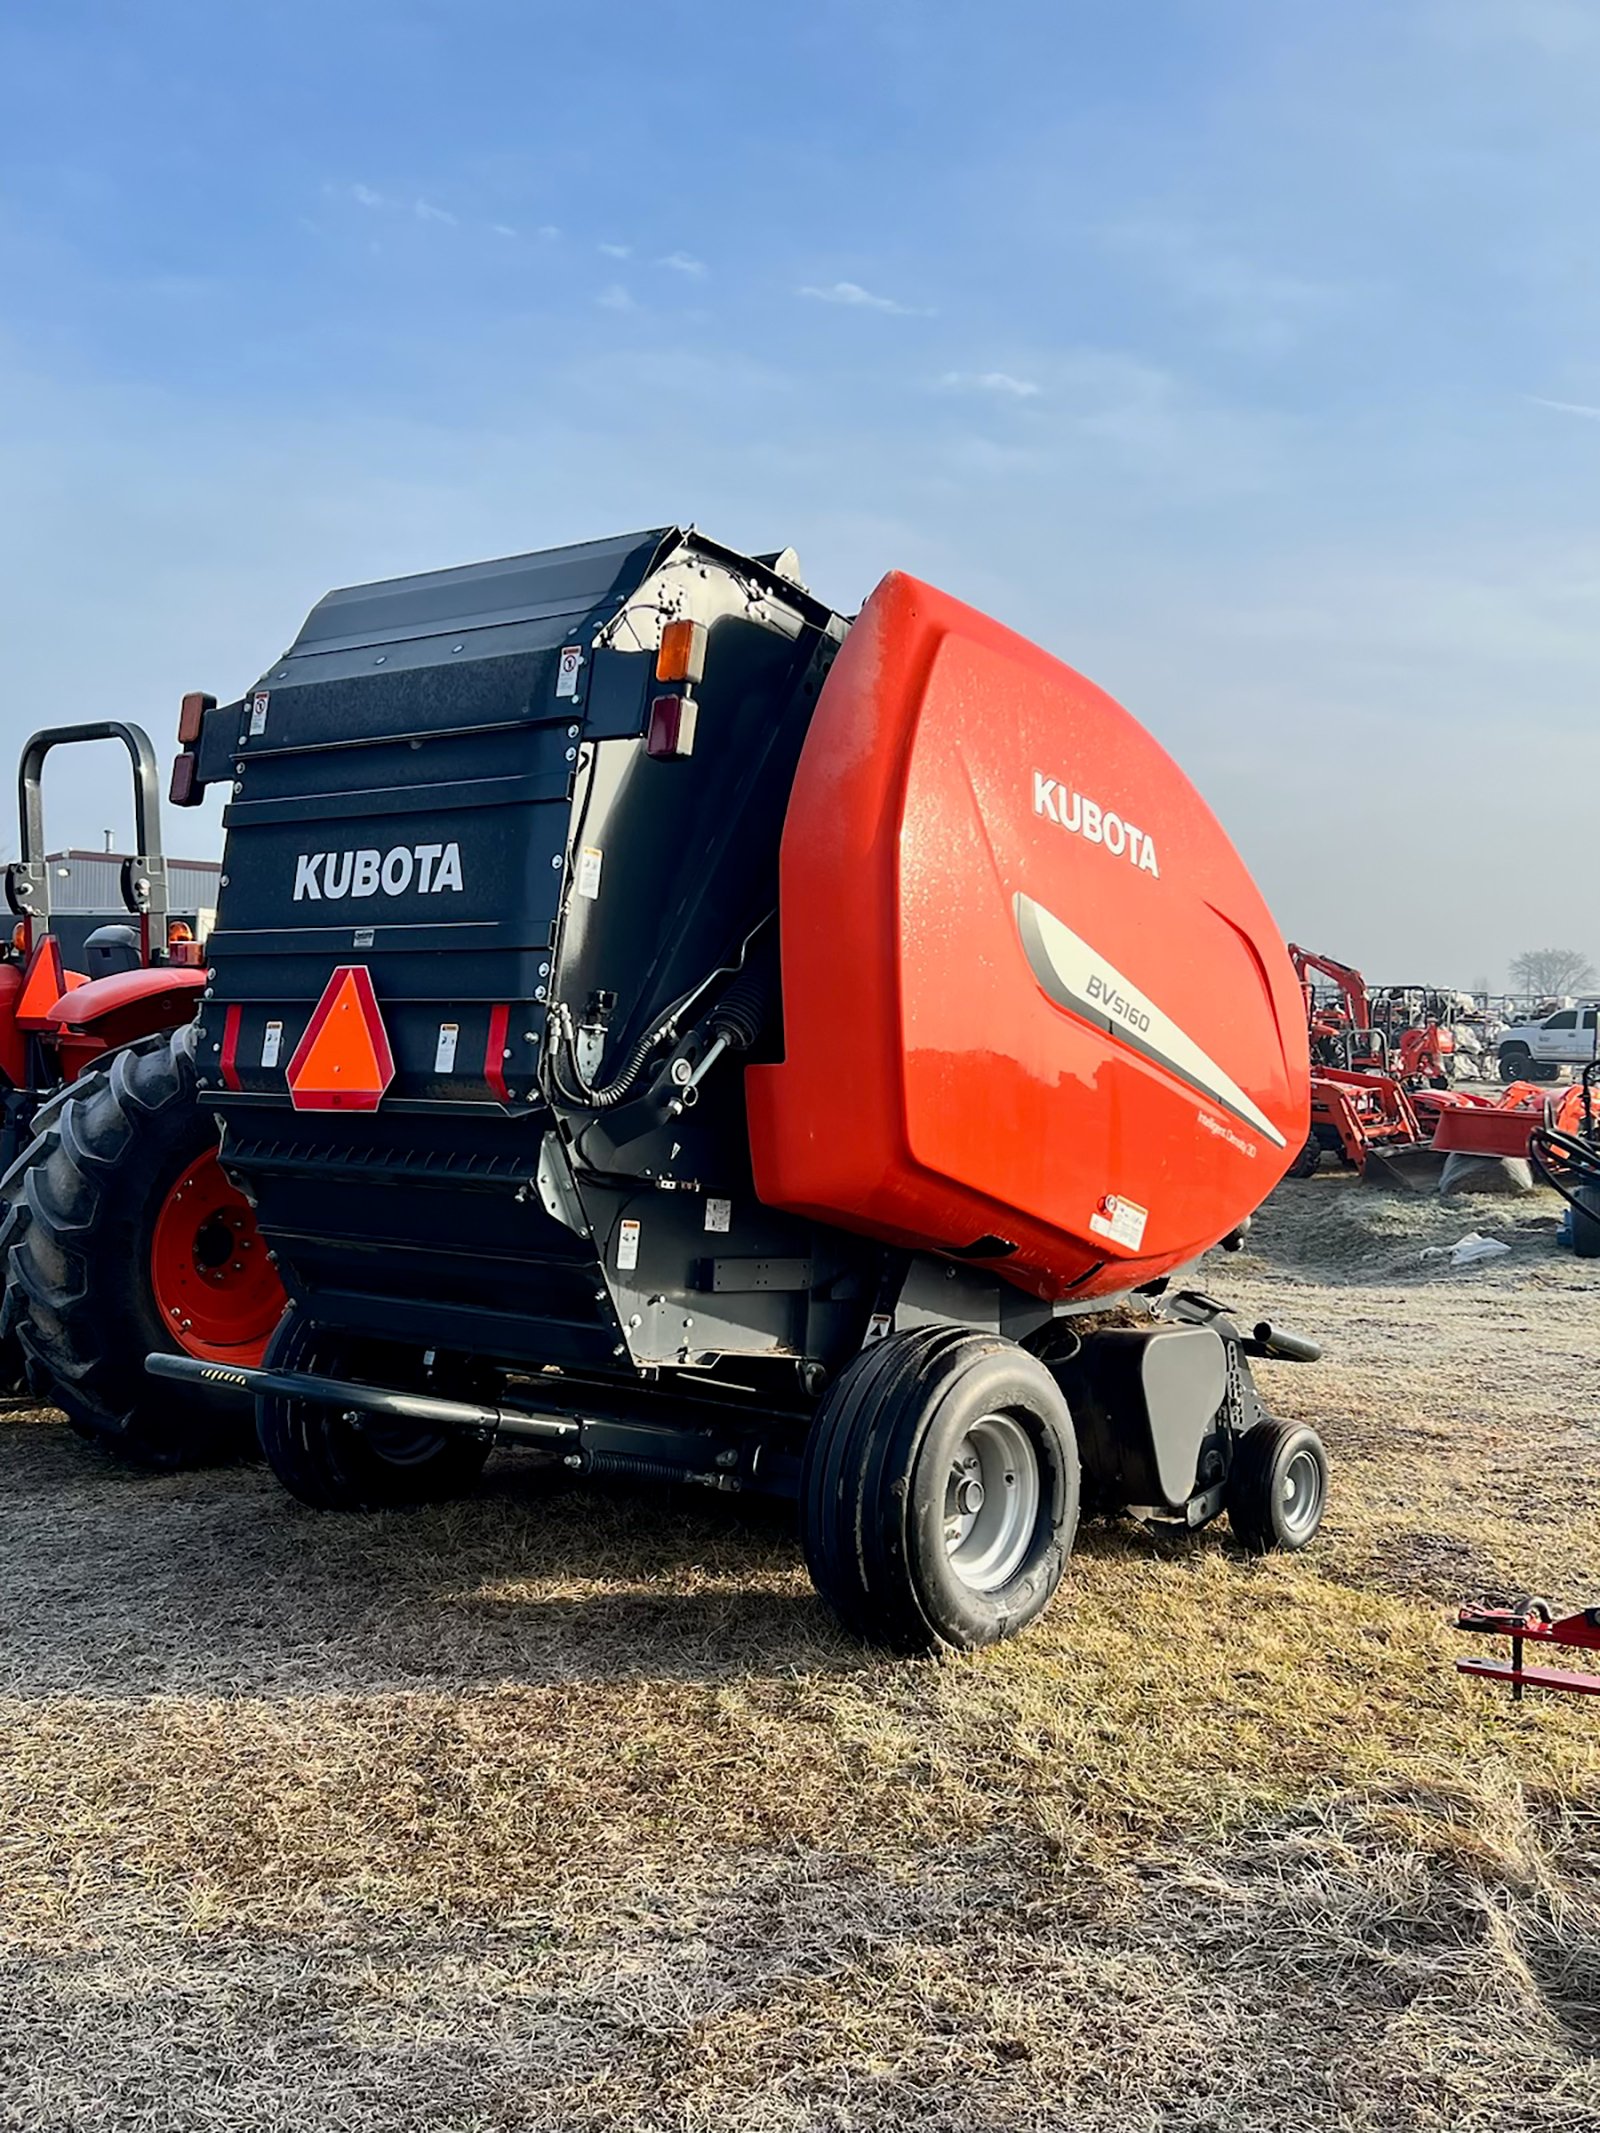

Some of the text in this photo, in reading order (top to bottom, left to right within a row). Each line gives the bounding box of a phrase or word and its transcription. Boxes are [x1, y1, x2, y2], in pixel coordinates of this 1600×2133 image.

[1033, 769, 1160, 880] KUBOTA
[292, 841, 464, 902] KUBOTA
[1085, 974, 1151, 1034] BV5160
